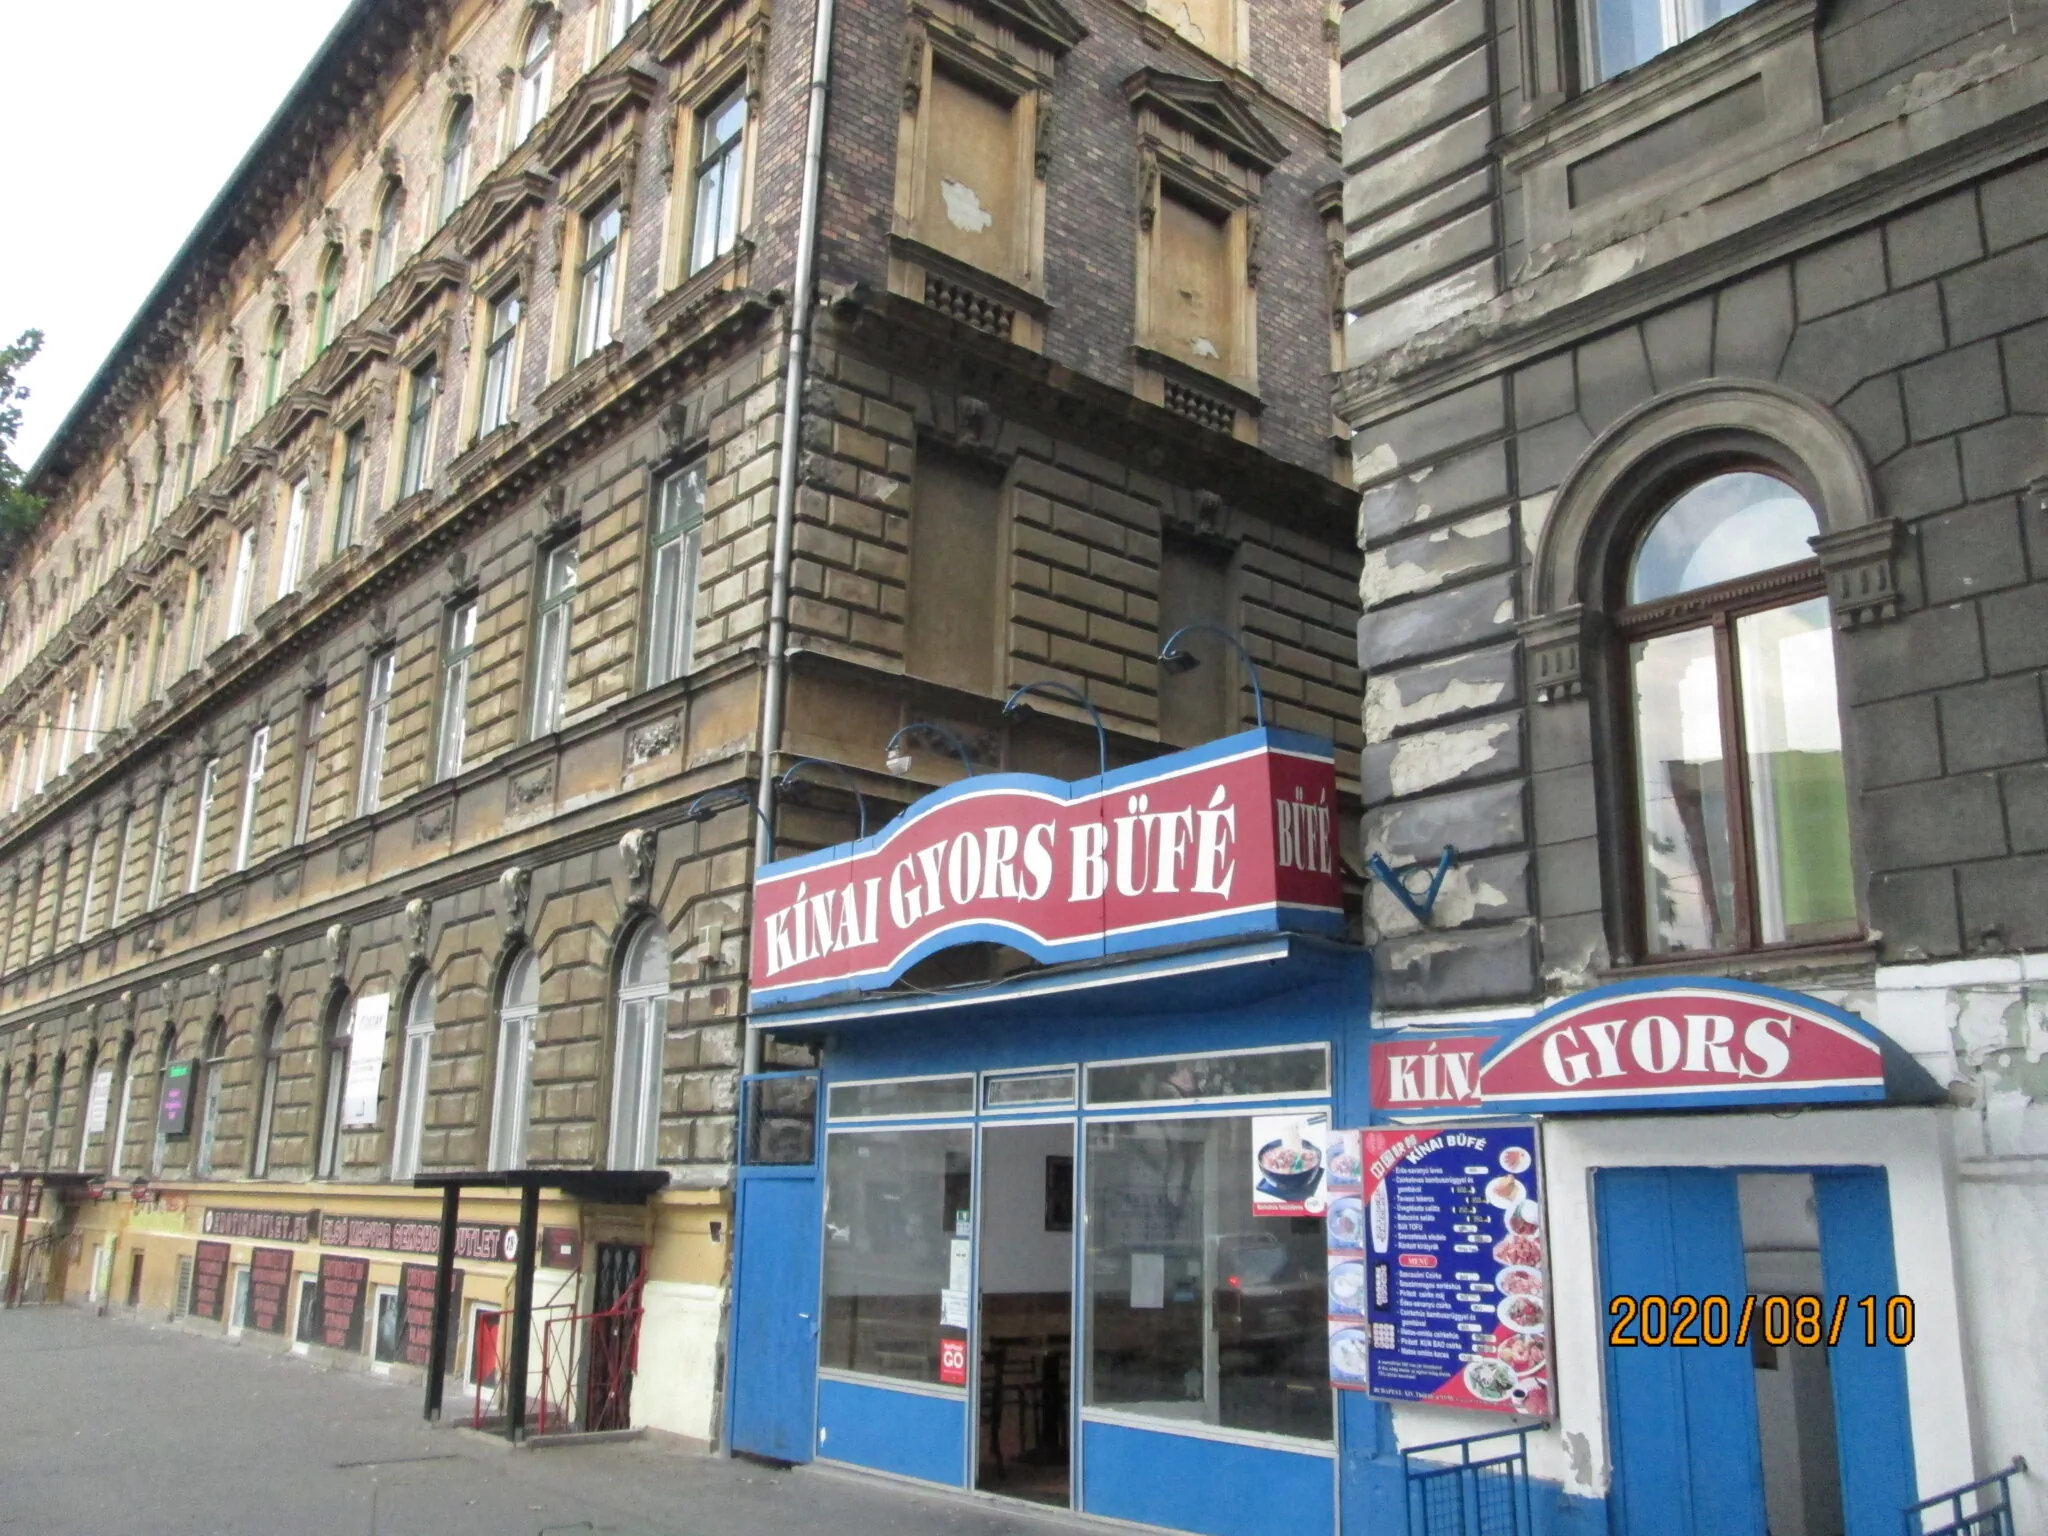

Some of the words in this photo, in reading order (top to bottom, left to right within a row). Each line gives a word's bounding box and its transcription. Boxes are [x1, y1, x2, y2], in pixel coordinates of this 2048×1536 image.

[1276, 786, 1332, 877] BÜFÉ
[764, 880, 881, 977] KÍNAI
[888, 817, 1056, 929] GYORS
[1068, 783, 1238, 902] BÜFÉ
[1388, 1041, 1483, 1101] KÍN
[1543, 1014, 1793, 1086] GYORS
[1406, 1136, 1444, 1165] KÍNAI
[1446, 1133, 1487, 1151] BÜFÉ
[943, 1351, 964, 1369] GO
